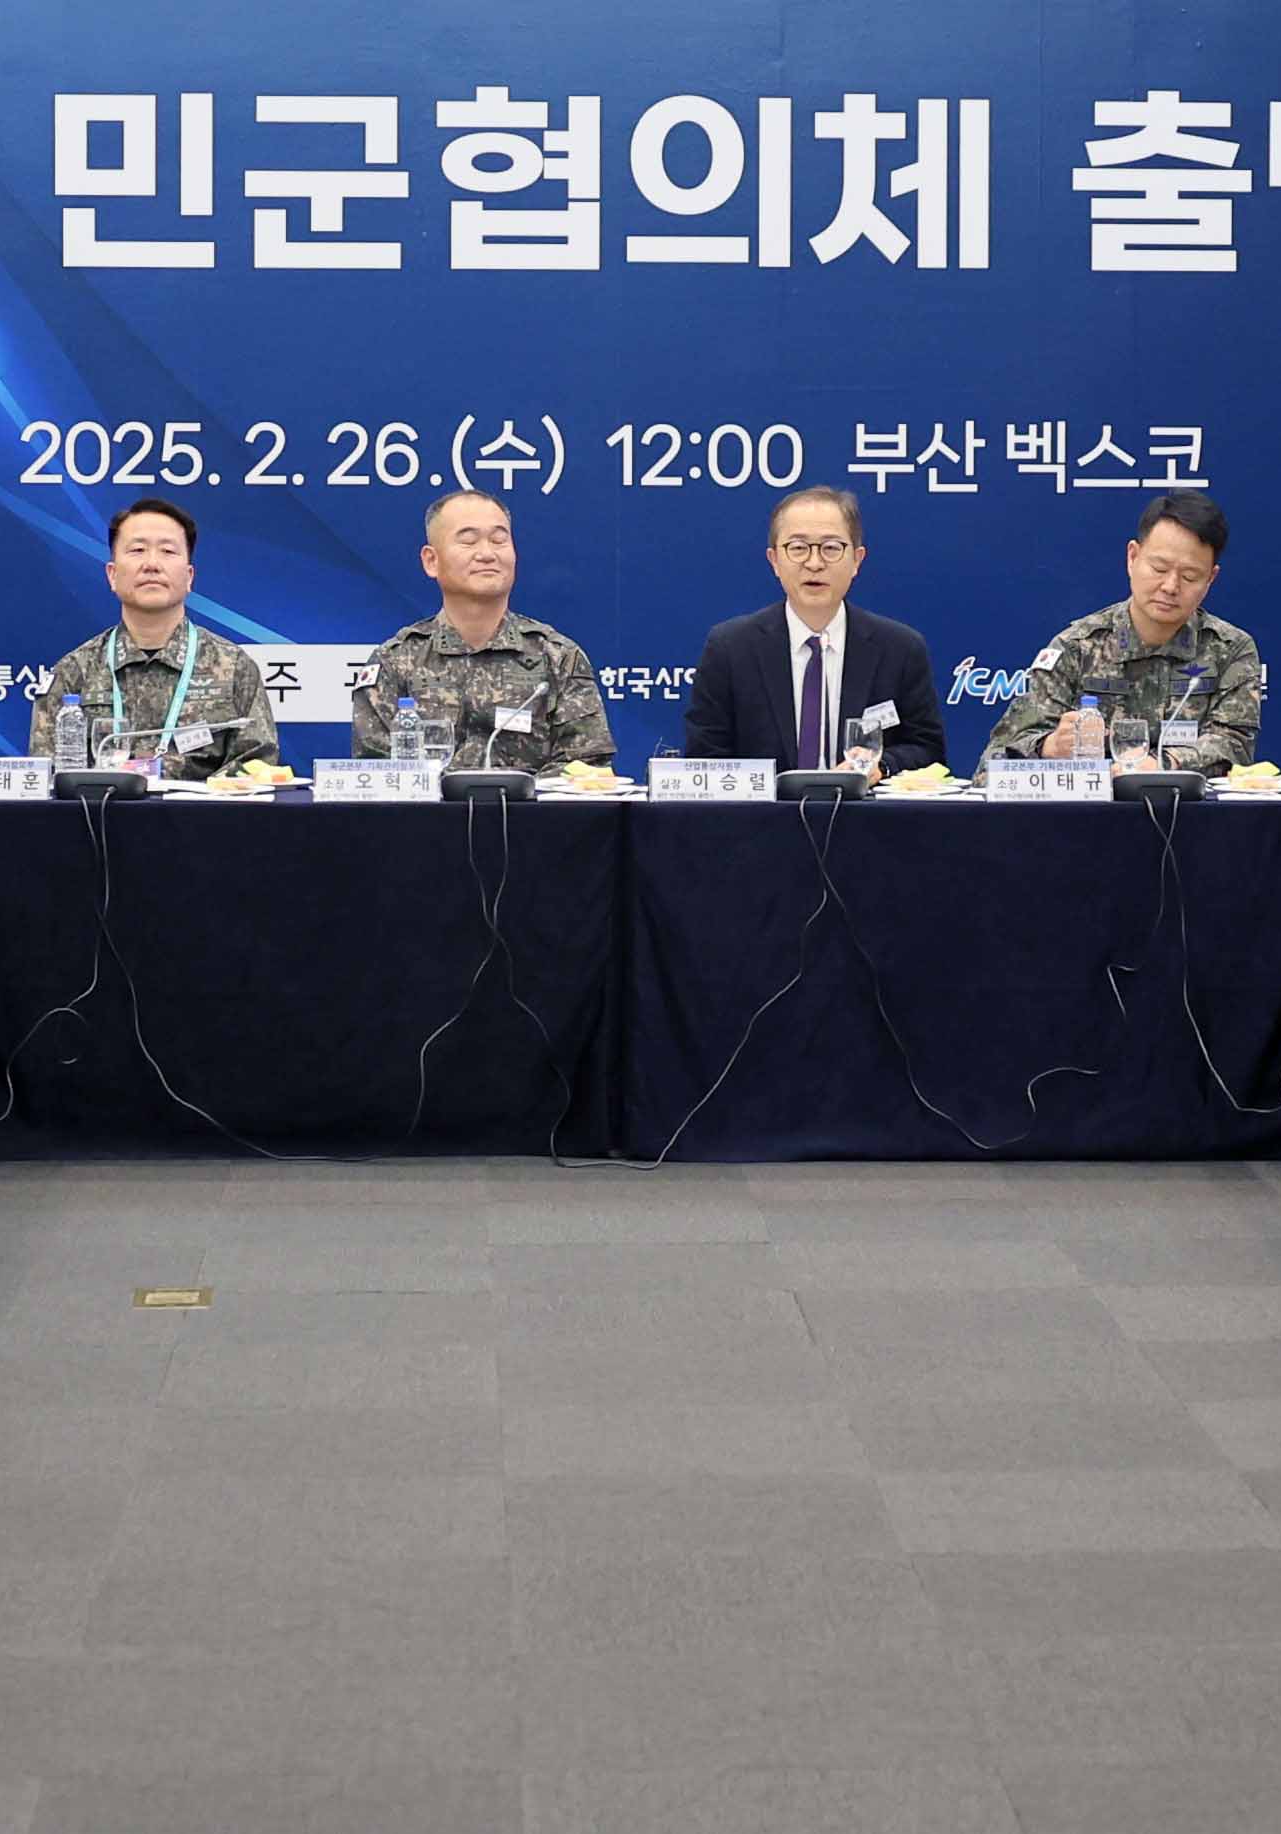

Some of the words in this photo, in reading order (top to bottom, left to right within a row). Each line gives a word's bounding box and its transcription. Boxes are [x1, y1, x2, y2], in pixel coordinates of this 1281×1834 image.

[55, 87, 989, 269] 민군협의체
[21, 421, 219, 484] 2025.
[245, 422, 303, 485] 2.
[607, 424, 802, 487] 12:00
[847, 421, 985, 493] 부산
[1007, 421, 1209, 493] 벡스코
